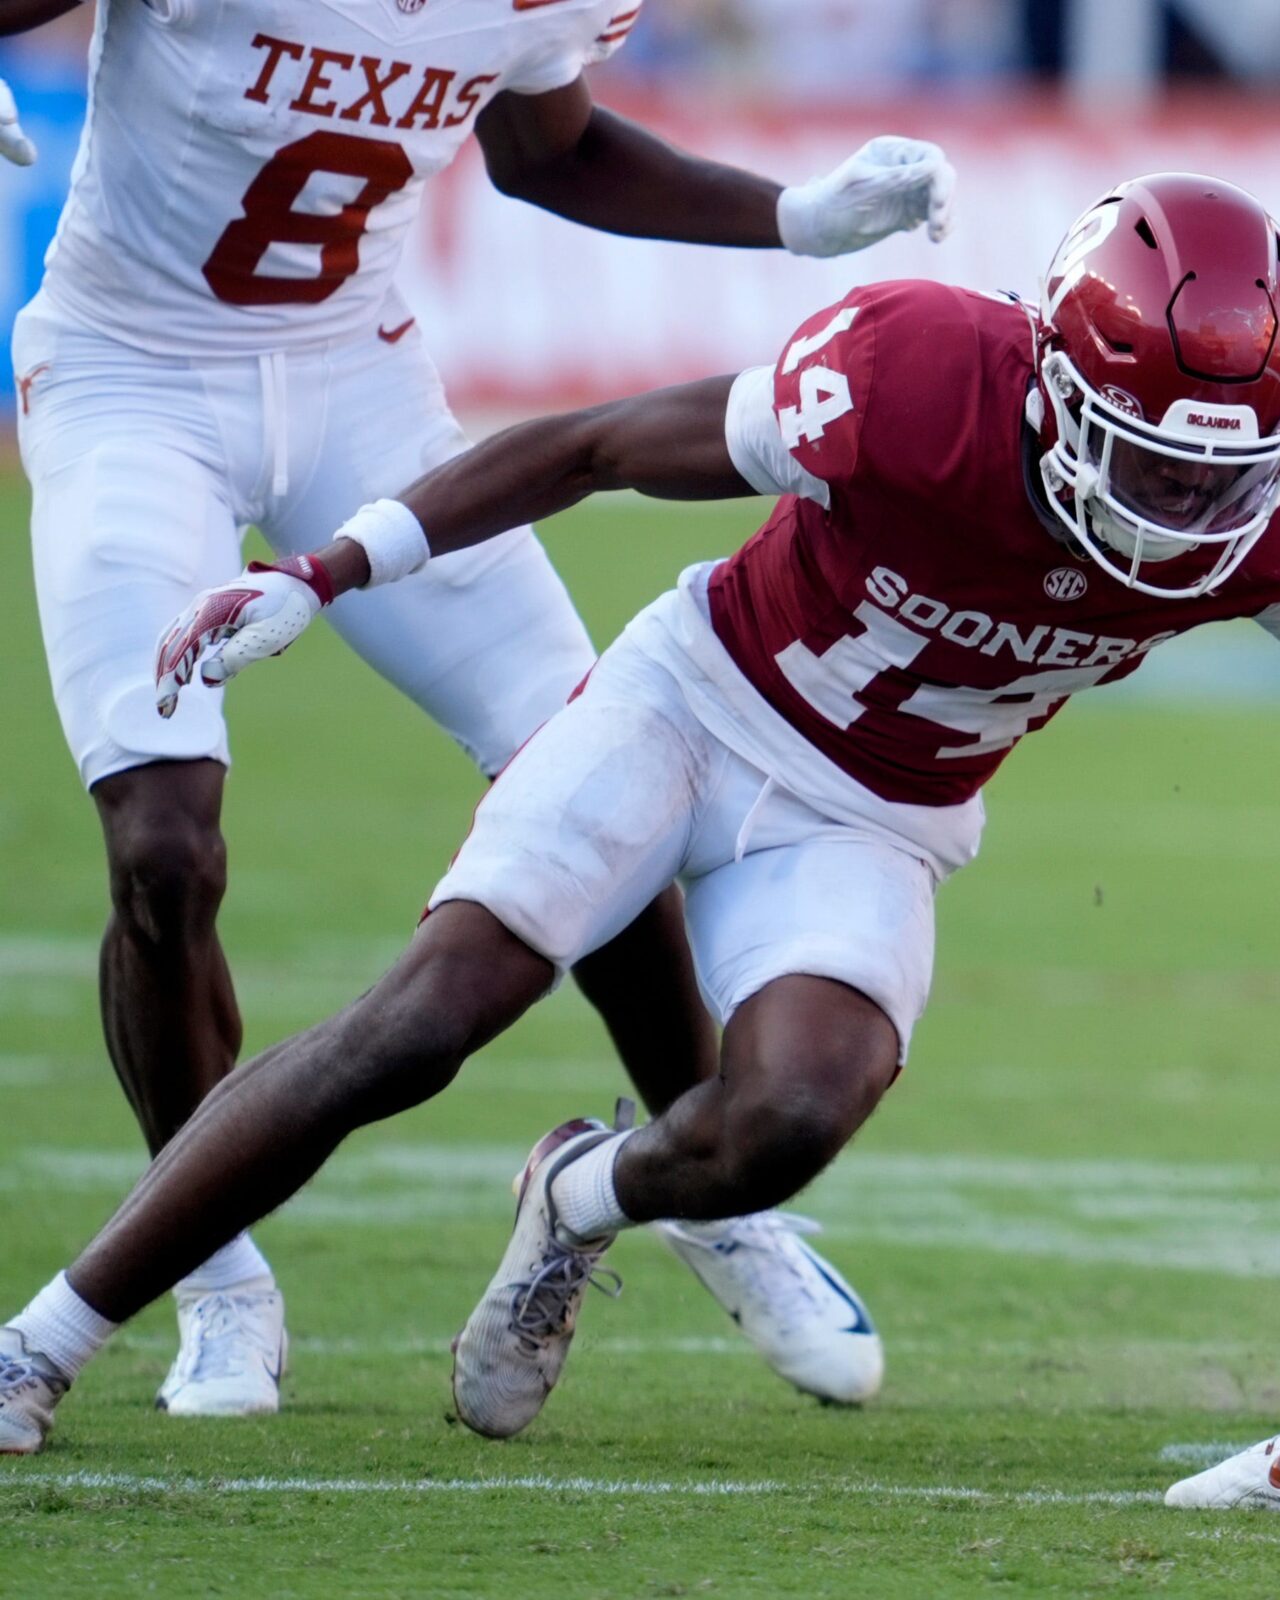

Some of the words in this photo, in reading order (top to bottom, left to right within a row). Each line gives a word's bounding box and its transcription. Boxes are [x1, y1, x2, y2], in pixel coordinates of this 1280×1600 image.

[243, 33, 501, 131] TEXAS
[202, 129, 414, 306] 8
[778, 306, 861, 447] 14
[1186, 413, 1241, 430] OKLAHOMA
[865, 566, 1178, 667] SOONERS
[1044, 568, 1088, 600] SEC
[774, 600, 1116, 759] 14
